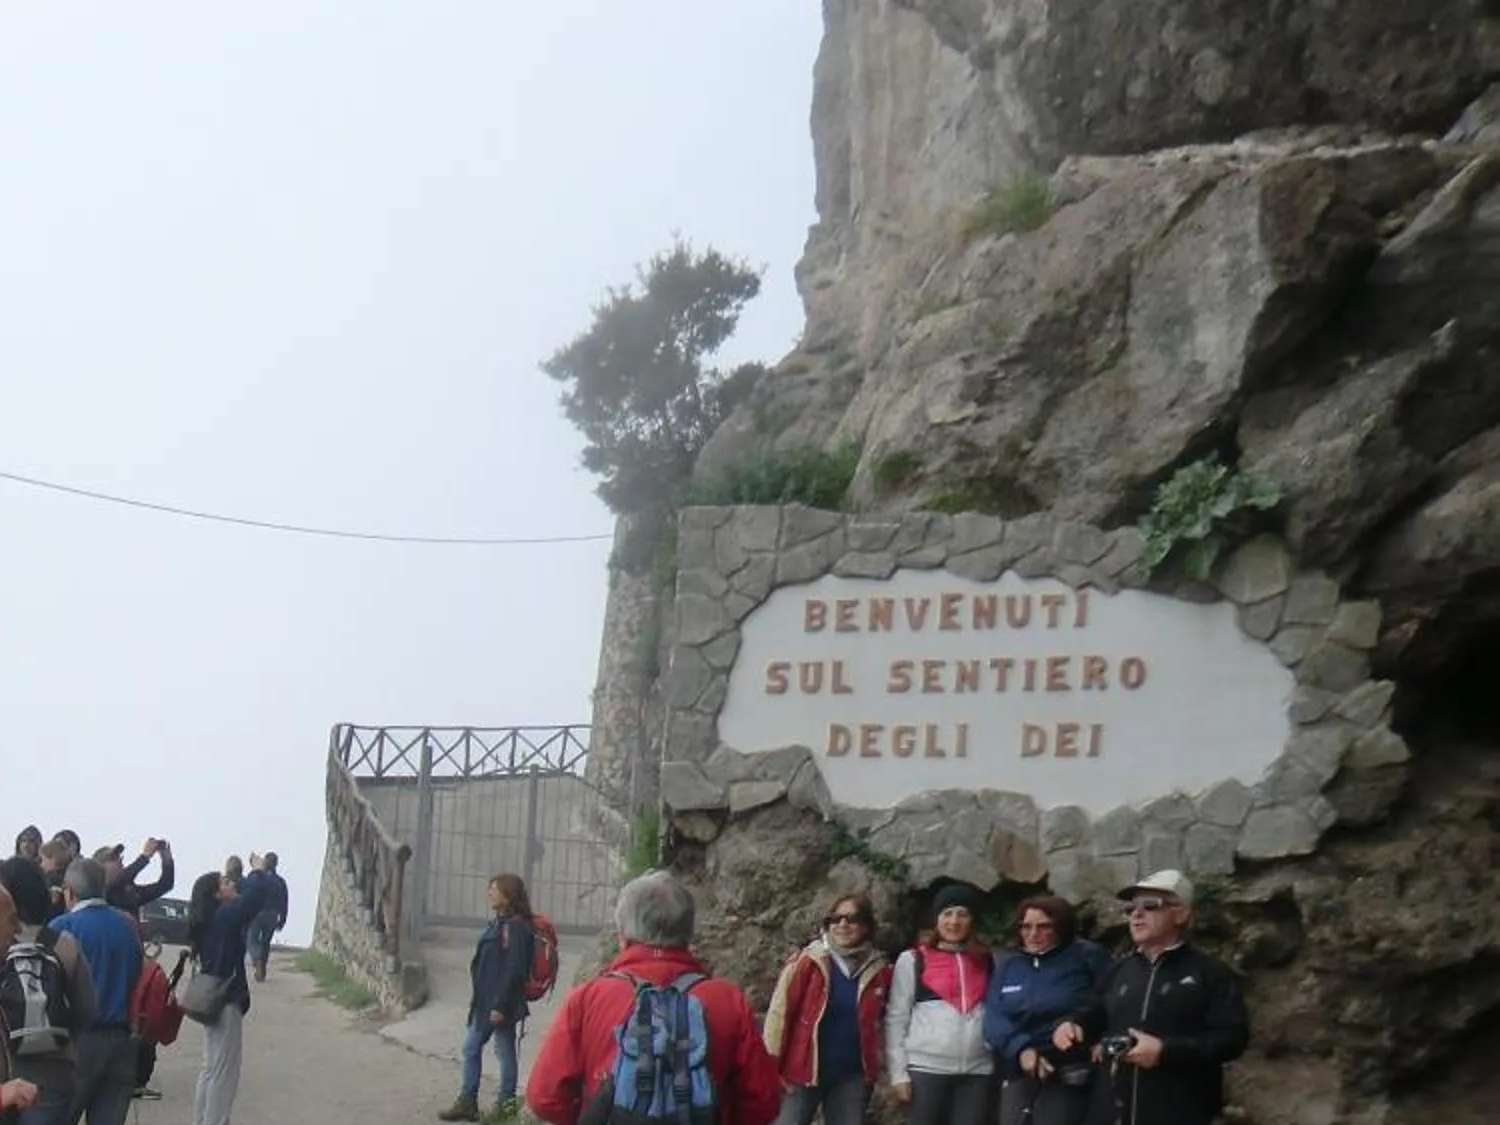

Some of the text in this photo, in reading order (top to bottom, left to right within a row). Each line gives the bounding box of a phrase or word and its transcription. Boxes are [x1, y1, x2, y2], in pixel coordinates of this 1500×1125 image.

[803, 592, 1090, 633] BENVENUTI
[765, 655, 1148, 695] SUL SENTIERO
[825, 722, 1105, 759] DEGLI DEI
